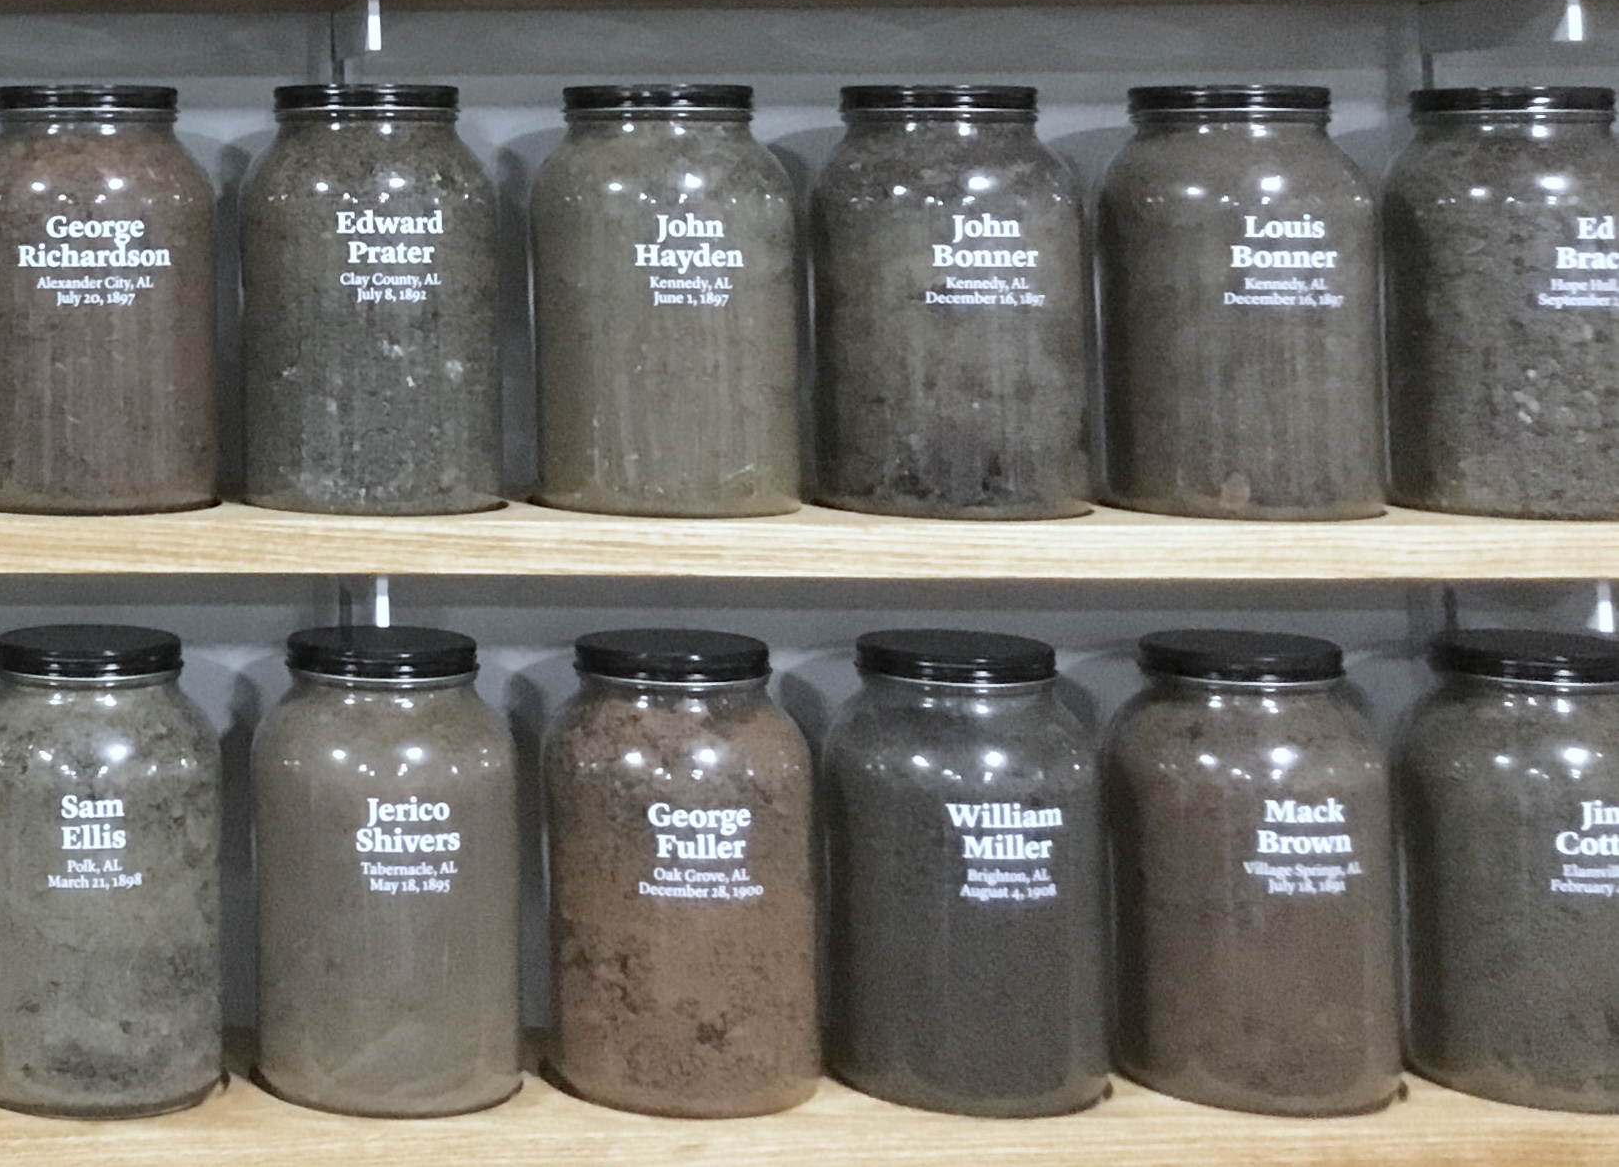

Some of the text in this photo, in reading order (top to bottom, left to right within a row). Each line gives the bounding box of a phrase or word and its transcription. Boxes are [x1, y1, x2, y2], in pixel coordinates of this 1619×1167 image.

[46, 215, 144, 246] George
[336, 210, 443, 234] Edward
[657, 213, 724, 243] John
[952, 213, 1020, 243] John
[1244, 214, 1325, 238] Louis
[1576, 215, 1615, 239] Ed
[18, 243, 171, 267] Richardson
[348, 241, 435, 264] Prater
[635, 243, 744, 274] Hayden
[932, 244, 1039, 267] Bonner
[1231, 245, 1338, 268] Bonner
[37, 277, 153, 291] Alexander City, AL
[340, 273, 441, 287] Clay County, AL
[649, 276, 732, 291] Kennedy, AL
[57, 292, 135, 306] July 20, 1897
[357, 288, 427, 303] July 8, 1892
[654, 292, 729, 307] June 1, 1897
[61, 795, 124, 819] Sam
[367, 795, 450, 827] Jerico
[648, 802, 751, 836] George
[945, 803, 1063, 829] William
[1264, 798, 1345, 823] Mack
[61, 824, 126, 850] Ellis
[356, 827, 461, 853] Shivers
[656, 834, 746, 860] Fuller
[962, 834, 1053, 860] Miller
[1257, 829, 1353, 855] Brown
[653, 868, 750, 883] Oak Grove, AL
